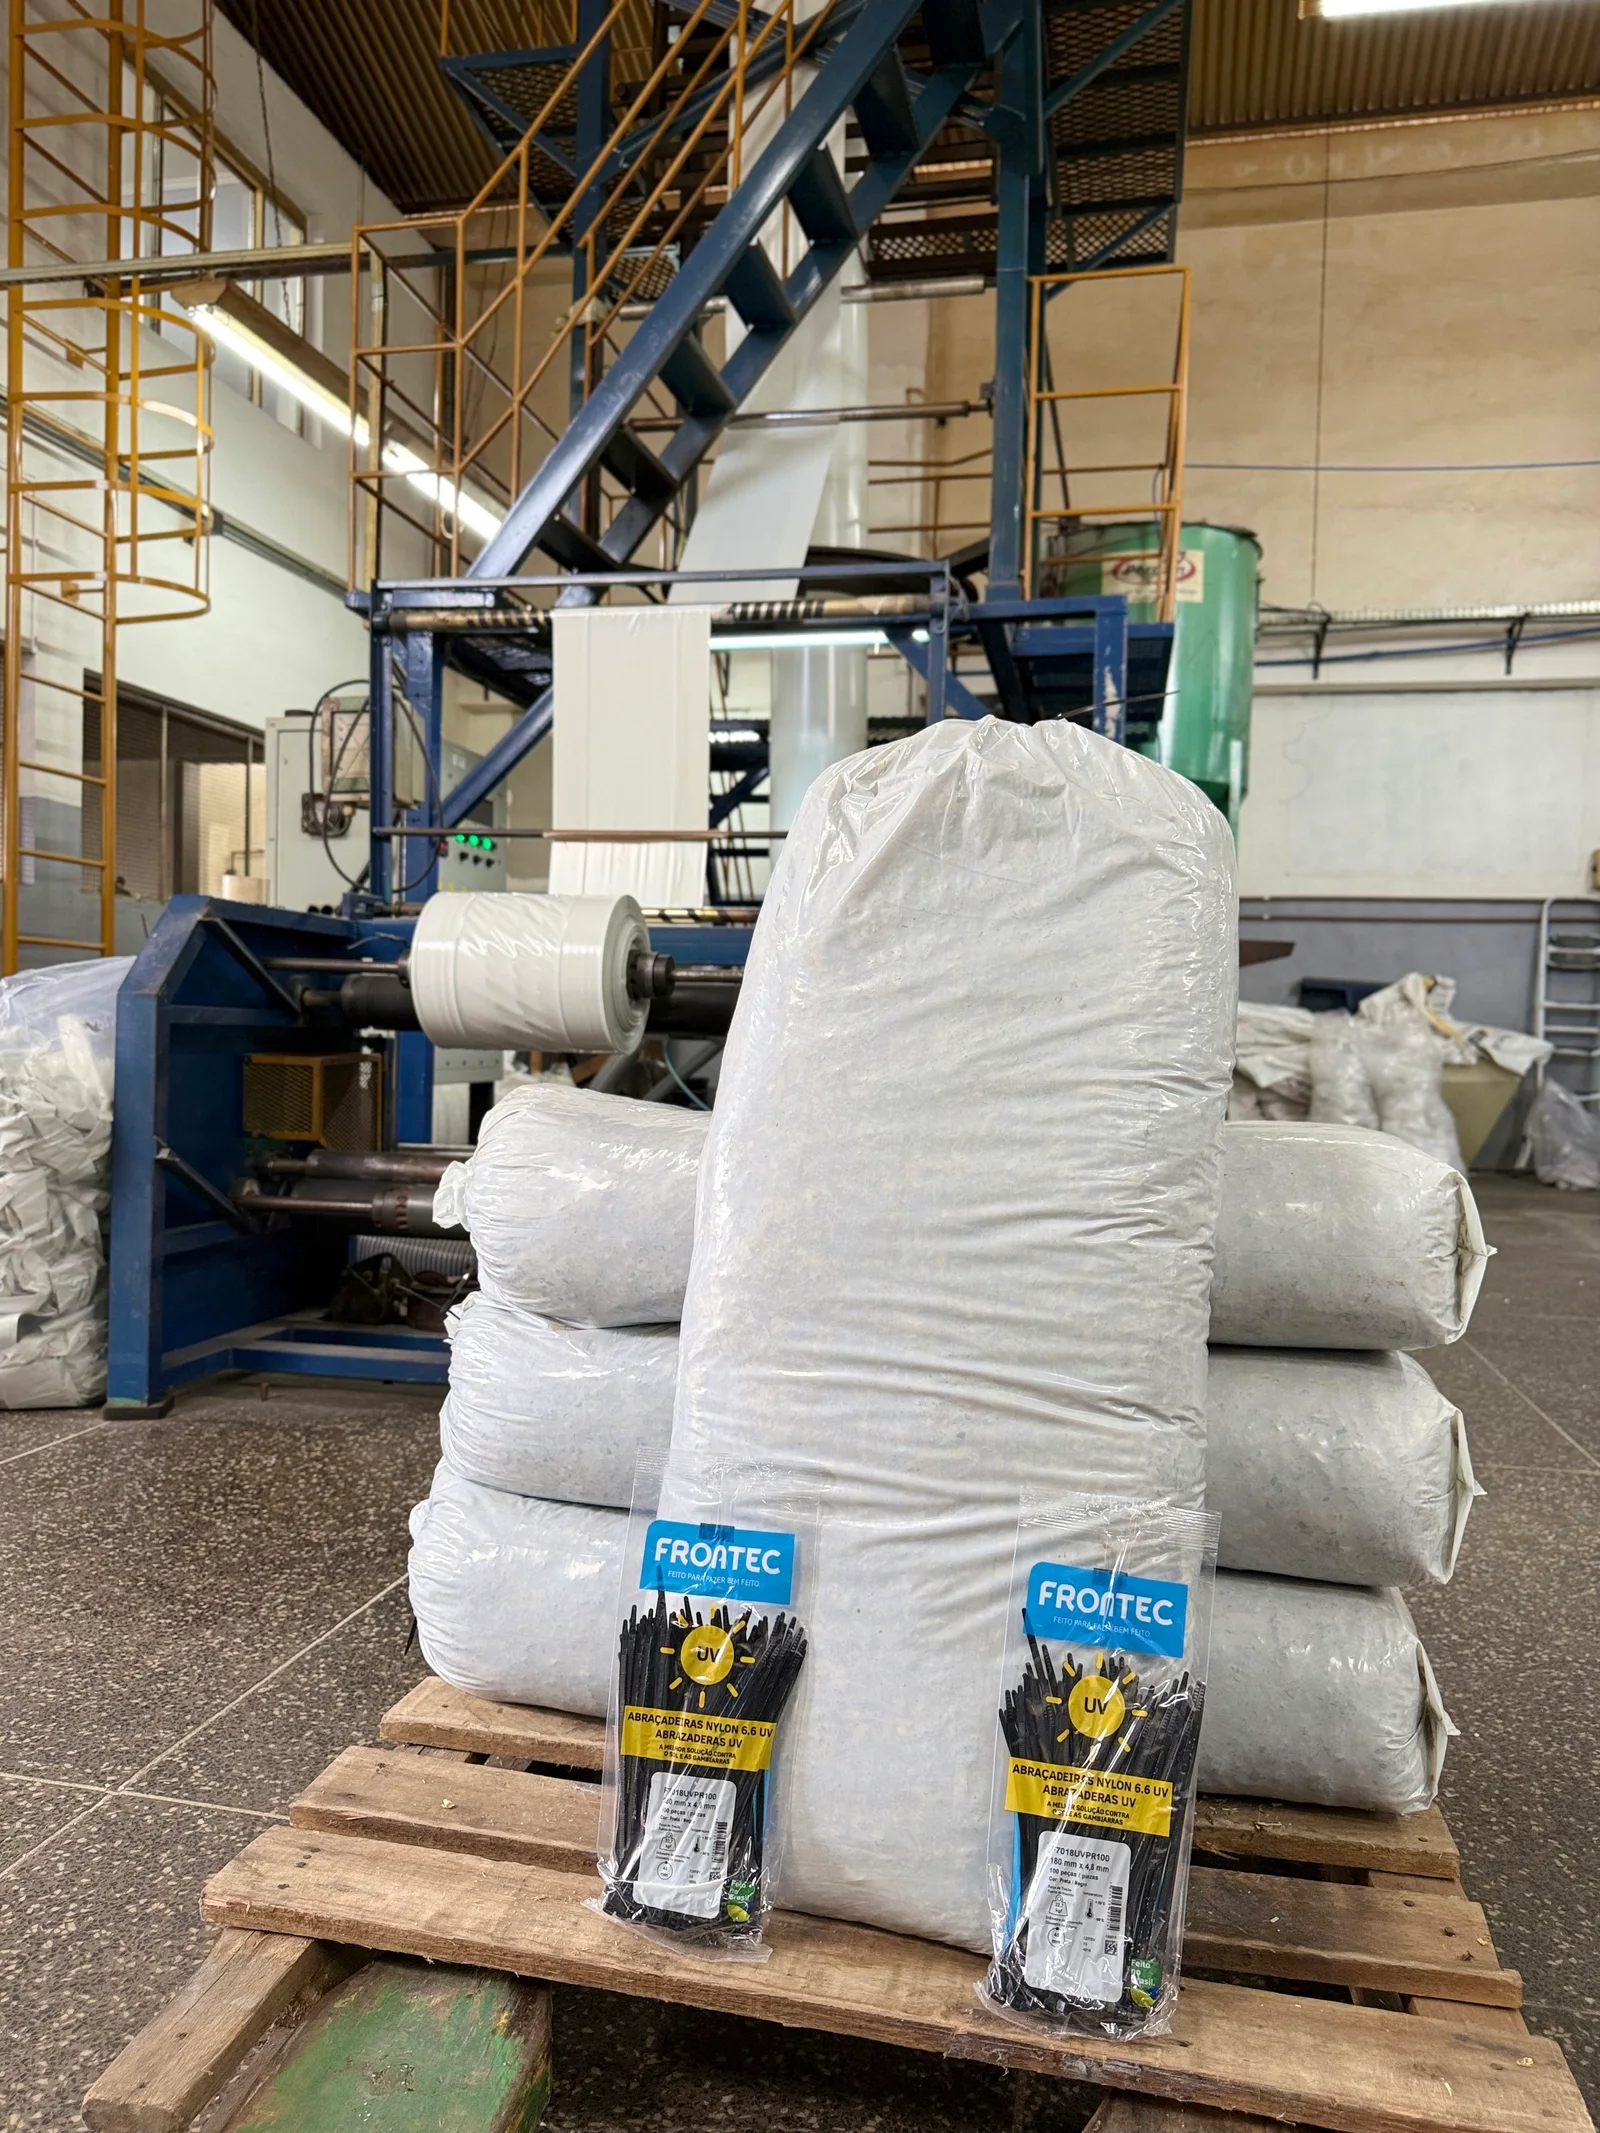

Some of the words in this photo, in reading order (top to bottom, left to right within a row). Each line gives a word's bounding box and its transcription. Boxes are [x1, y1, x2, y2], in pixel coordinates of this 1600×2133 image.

[668, 1570, 688, 1579] FEITO
[687, 1572, 705, 1582] PARA
[706, 1576, 727, 1584] FAZER
[726, 1577, 740, 1585] BEM
[1053, 1616, 1073, 1626] FEITO
[1073, 1619, 1092, 1630] PARA
[1114, 1625, 1130, 1634] BEM
[696, 1646, 720, 1663] UV
[1084, 1697, 1109, 1715] UV
[627, 1711, 704, 1730] ABRAÇADEIRAS
[706, 1721, 739, 1734] NYLON
[741, 1726, 757, 1736] 6.6
[759, 1728, 774, 1738] UV
[655, 1729, 726, 1747] ABRAZADERAS
[728, 1738, 743, 1749] UV
[664, 1744, 686, 1754] MELHOR
[686, 1746, 713, 1757] SOLUÇÃO
[713, 1750, 736, 1760] CONTRA
[692, 1755, 730, 1765] GAMBIARRAS
[1012, 1764, 1095, 1786] ABRAÇADEIRAS
[1096, 1778, 1132, 1792] NYLON
[1134, 1783, 1151, 1795] 6.6
[1153, 1786, 1169, 1798] UV
[1042, 1784, 1119, 1805] ABRAZADERAS
[1121, 1796, 1137, 1808] UV
[670, 1808, 686, 1816] peças
[1046, 1800, 1052, 1808] A
[1076, 1804, 1105, 1816] SOLUÇÃO
[1105, 1810, 1130, 1819] CONTRA
[1082, 1814, 1124, 1826] GAMBIARRAS
[1053, 1846, 1110, 1862] 7018UVPR100
[1050, 1856, 1063, 1866] 180
[1064, 1860, 1078, 1868] mm
[1084, 1863, 1095, 1872] 4,8
[1096, 1865, 1110, 1873] mm
[1060, 1869, 1077, 1878] peças
[1131, 1959, 1151, 1969] Feito
